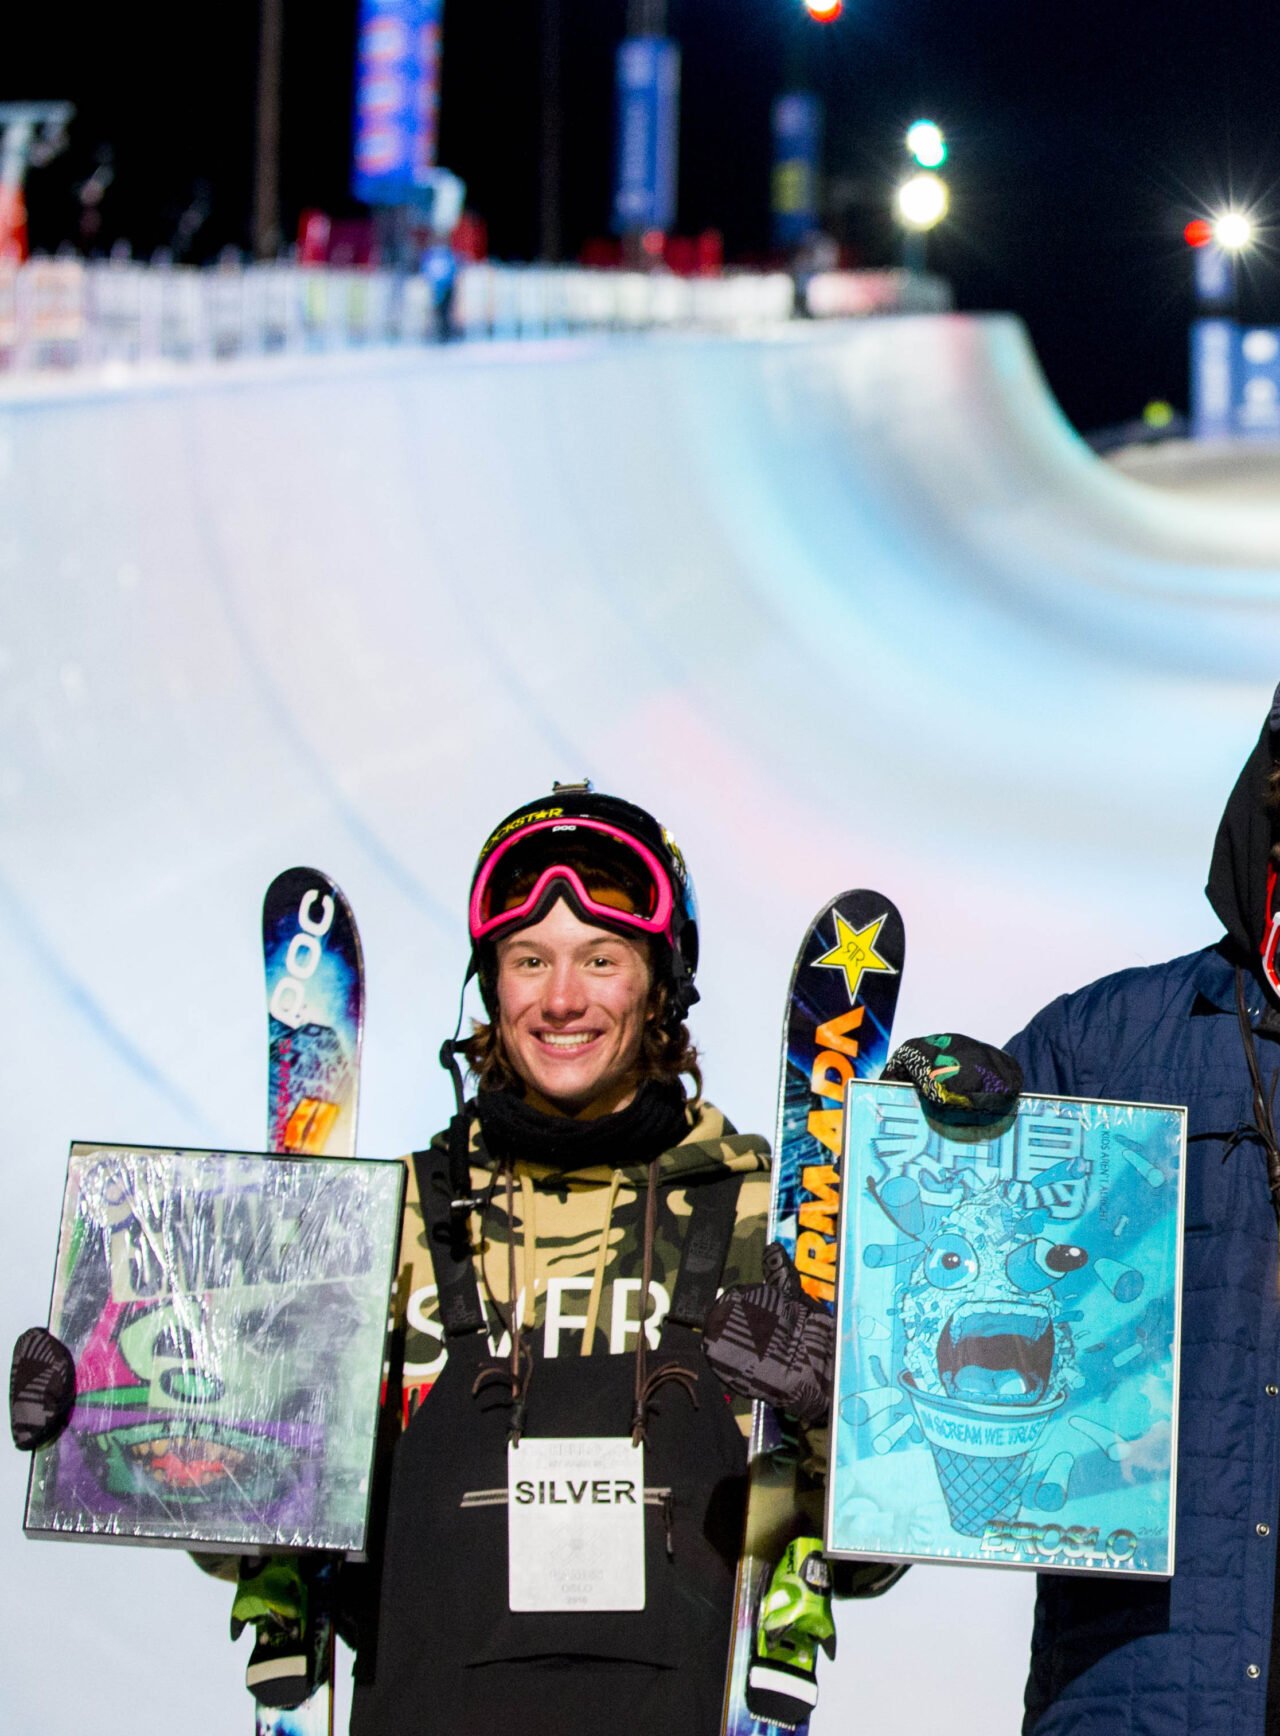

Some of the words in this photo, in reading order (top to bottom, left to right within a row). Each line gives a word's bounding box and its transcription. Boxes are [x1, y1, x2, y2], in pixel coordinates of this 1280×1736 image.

[269, 889, 335, 1030] POC
[934, 1415, 982, 1446] SCREAM
[985, 1427, 1004, 1446] WE
[514, 1480, 637, 1505] SILVER
